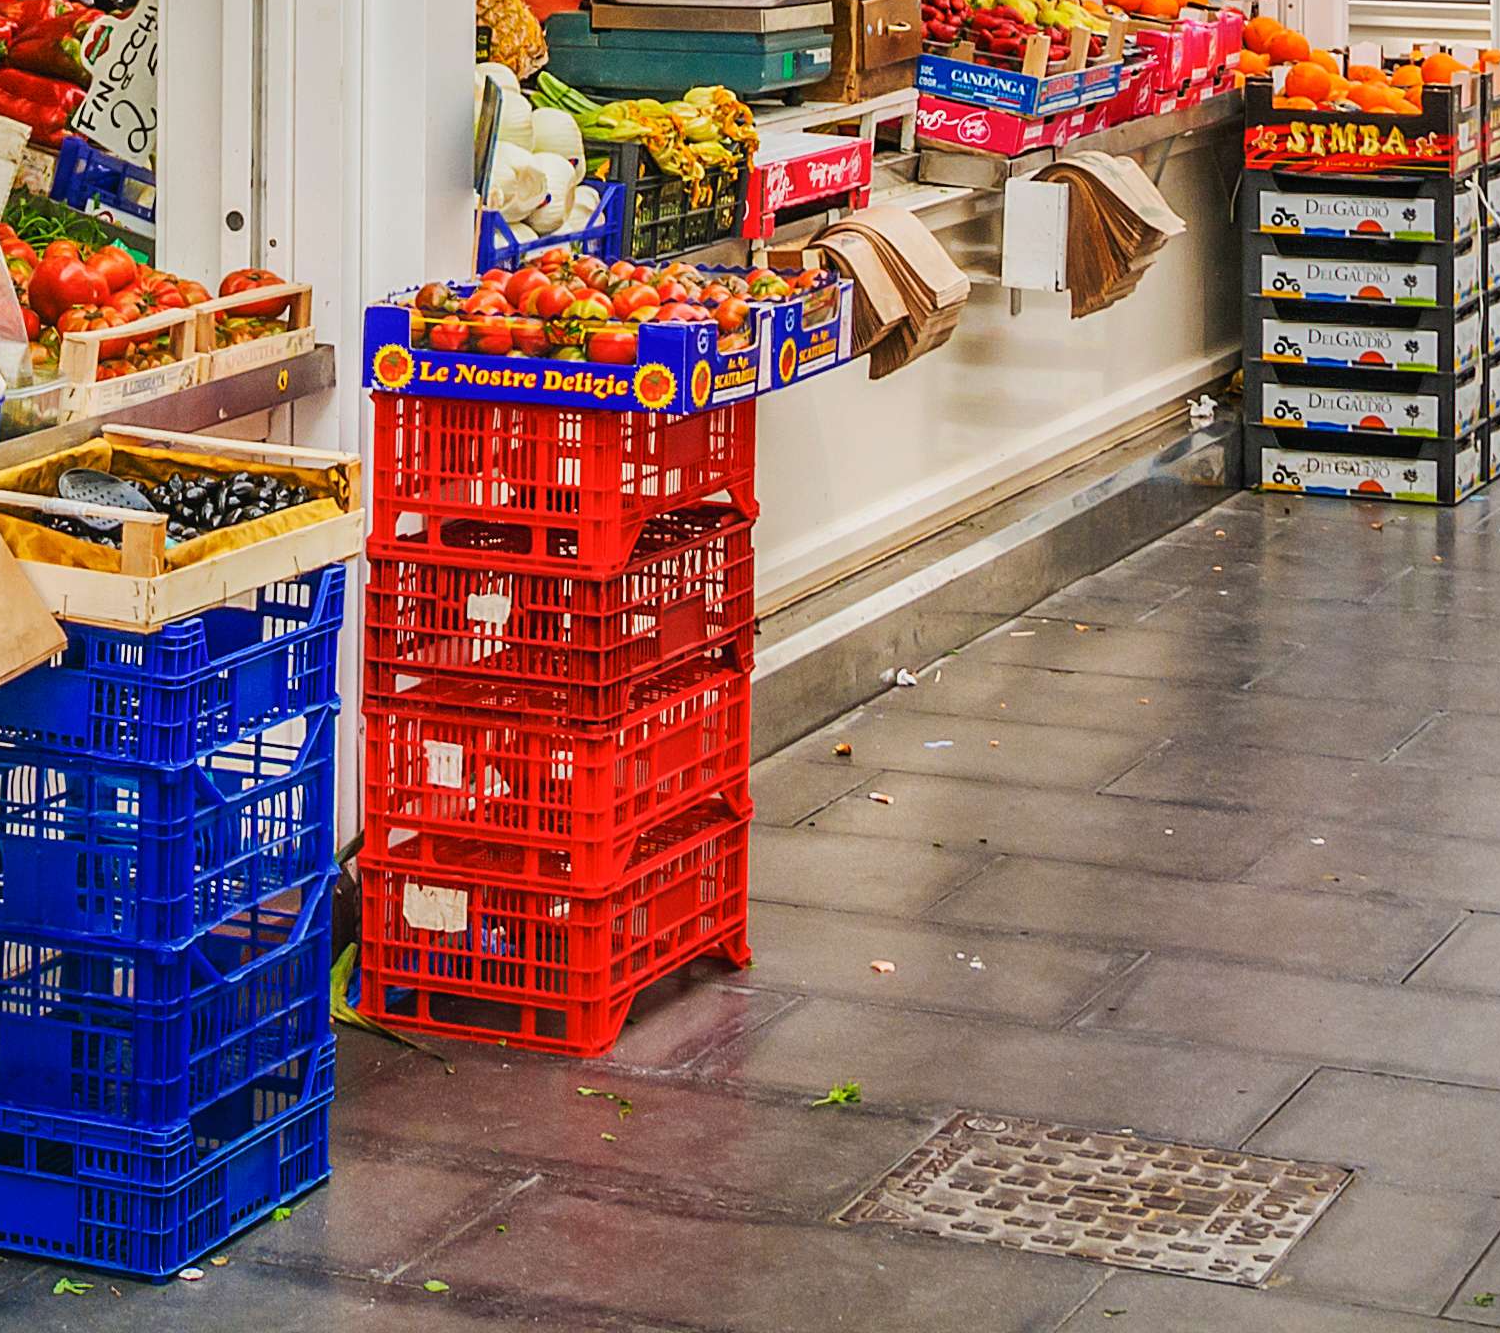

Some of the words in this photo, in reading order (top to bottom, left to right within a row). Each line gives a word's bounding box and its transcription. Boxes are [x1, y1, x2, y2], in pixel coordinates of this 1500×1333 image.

[1287, 122, 1409, 157] SIMBA
[418, 360, 450, 384] Le
[453, 364, 536, 391] Nostre
[542, 369, 630, 401] Delizie
